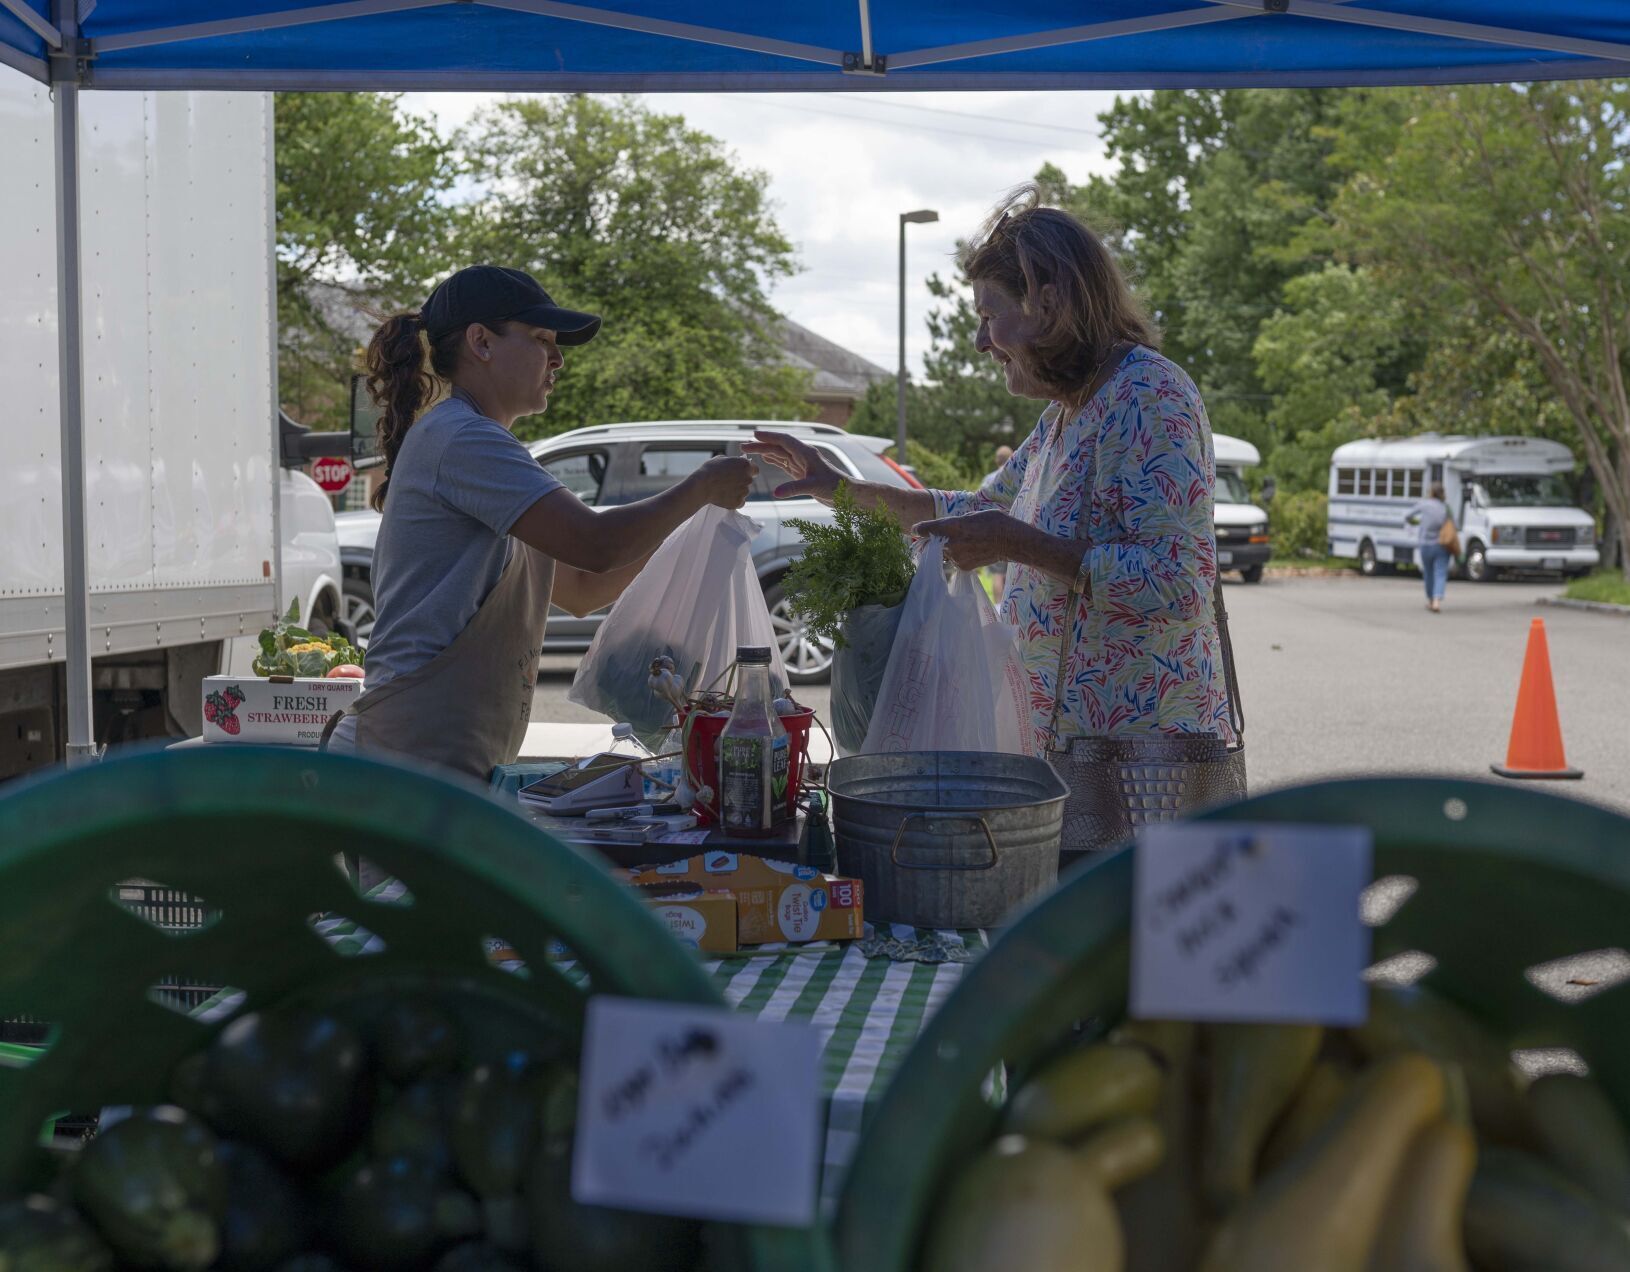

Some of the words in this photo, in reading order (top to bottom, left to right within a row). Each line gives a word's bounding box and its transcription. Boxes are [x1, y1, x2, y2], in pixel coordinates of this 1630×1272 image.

[315, 464, 350, 483] STOP
[312, 684, 326, 692] DRY
[326, 684, 353, 692] QUARTS
[273, 696, 328, 711] FRESH
[247, 712, 332, 725] STRAWBERR
[297, 731, 322, 739] PRODU
[839, 884, 852, 906] 100
[791, 892, 803, 916] Twist
[791, 917, 803, 933] Tie
